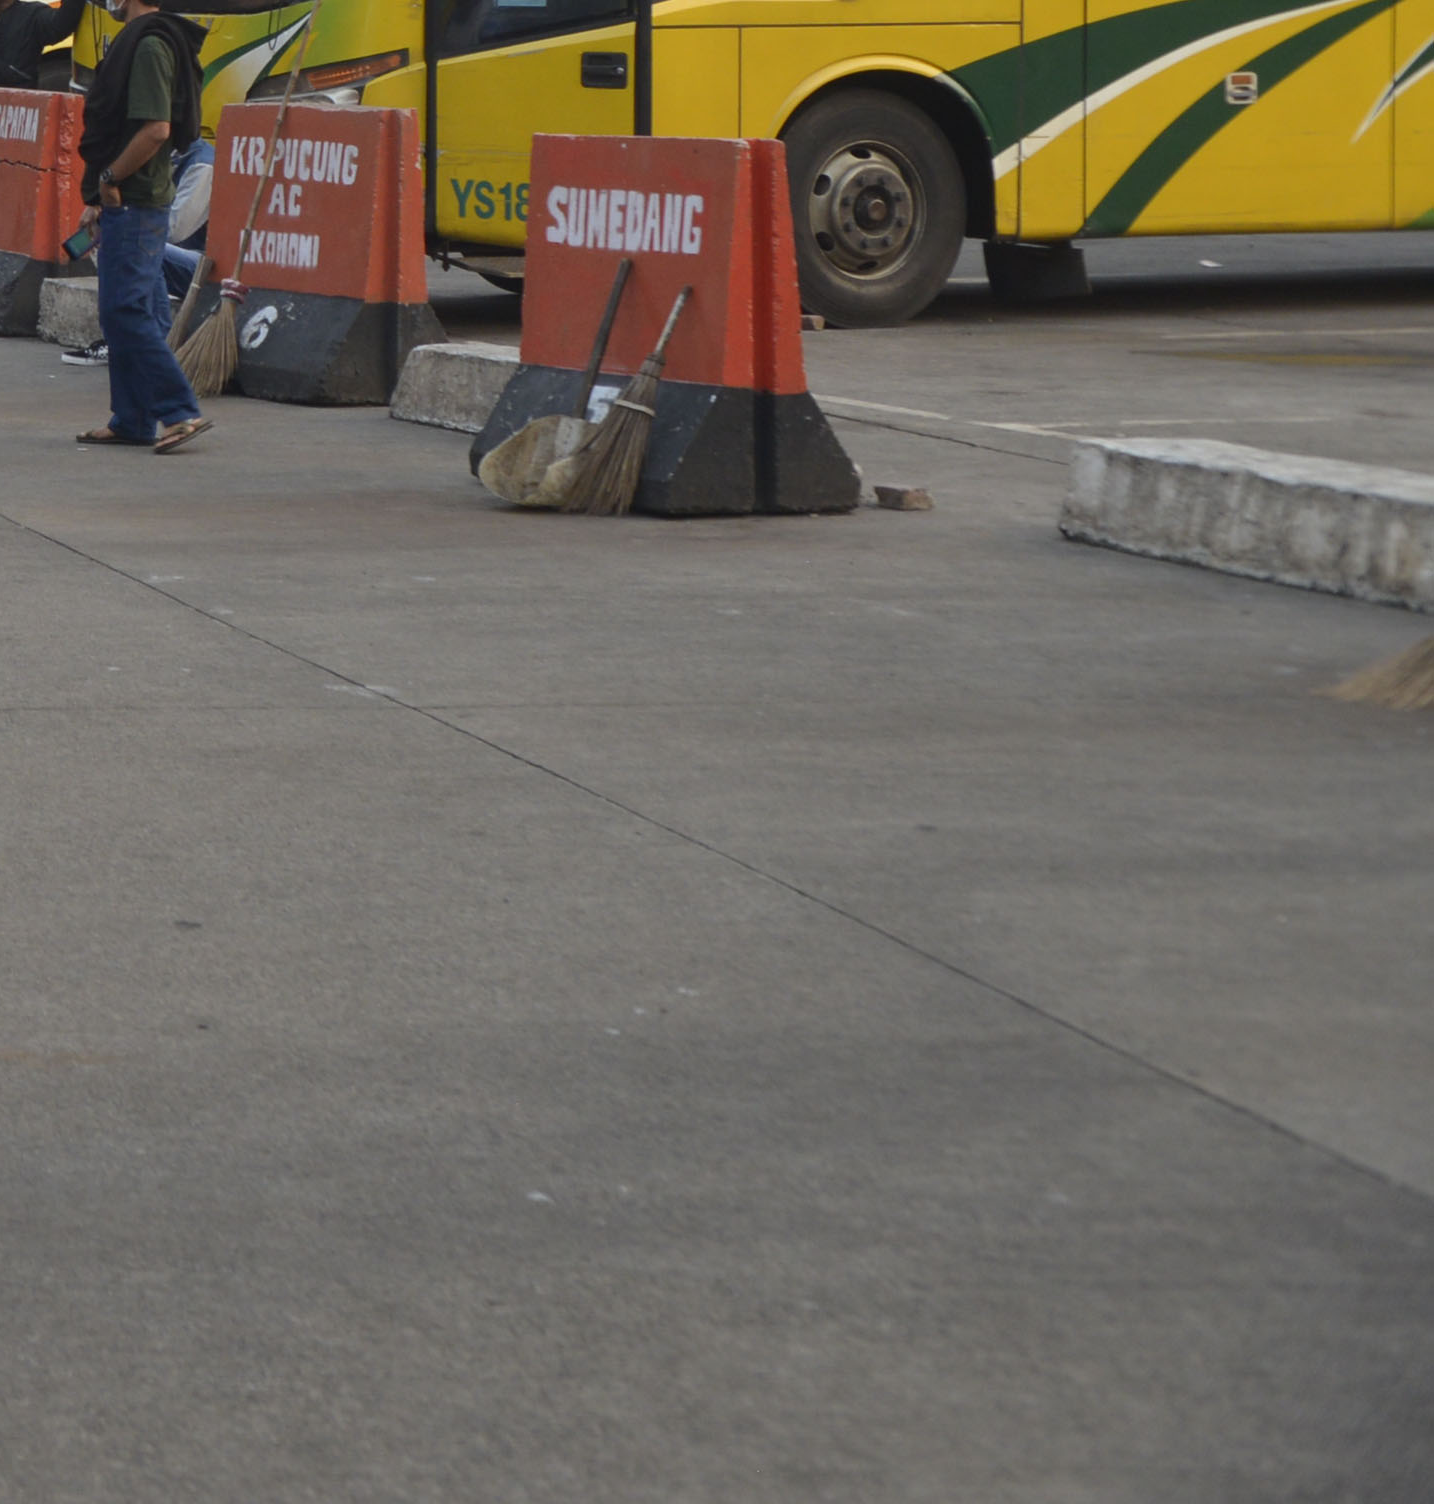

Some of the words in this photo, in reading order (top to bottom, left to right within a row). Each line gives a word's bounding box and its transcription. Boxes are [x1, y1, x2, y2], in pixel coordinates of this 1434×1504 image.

[267, 183, 303, 216] AC
[545, 185, 704, 255] SUMEDANG
[239, 305, 279, 349] 6
